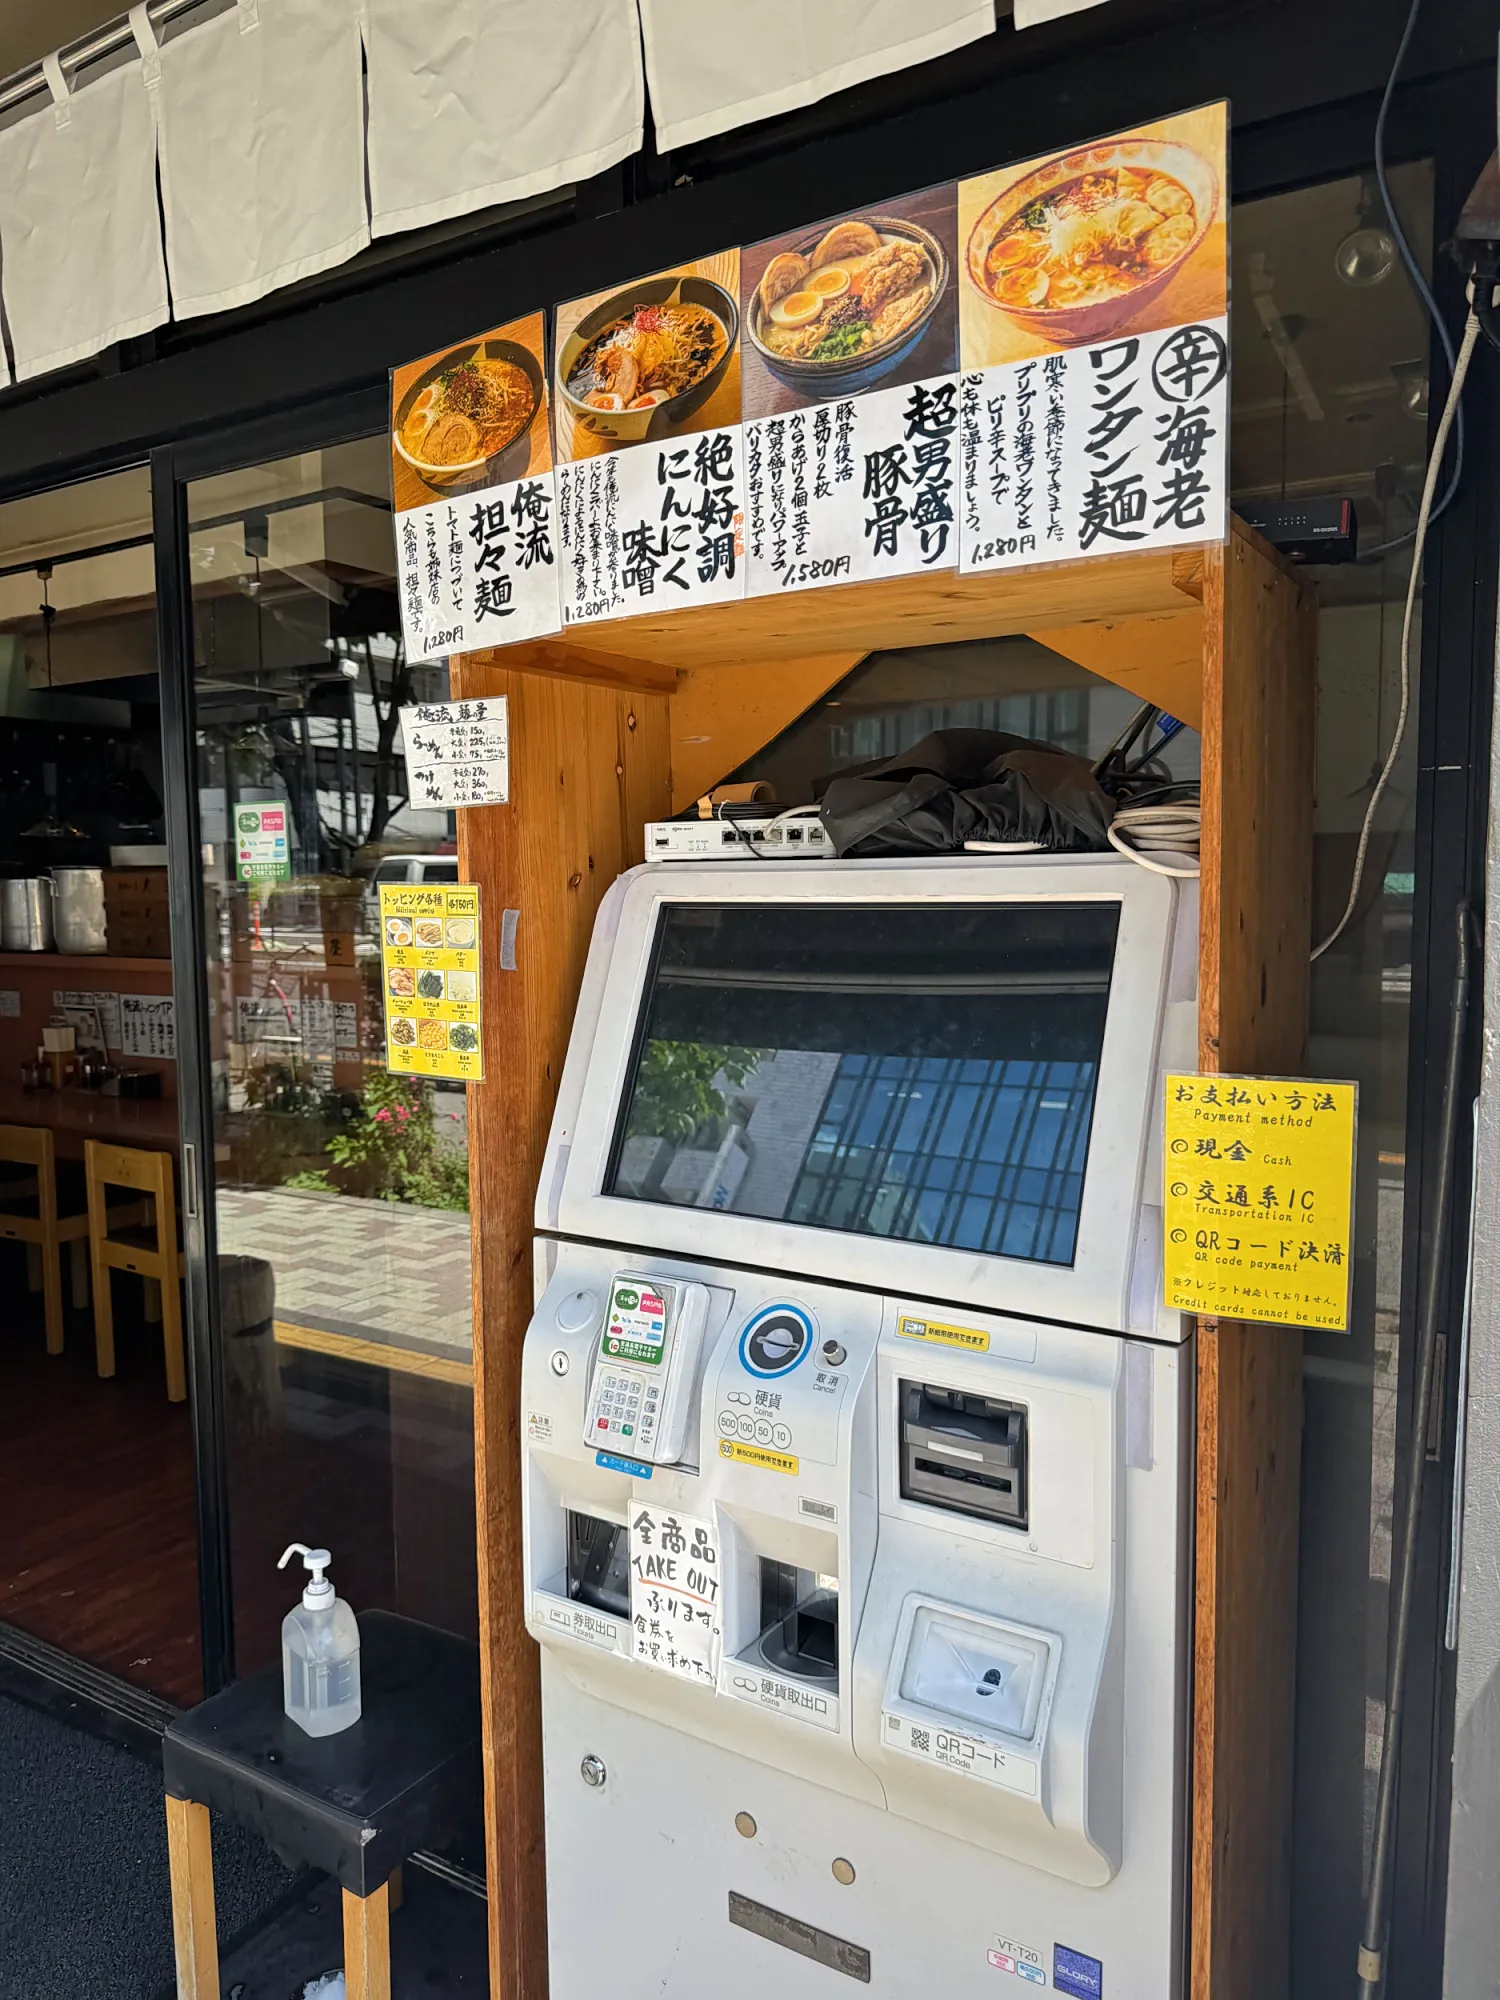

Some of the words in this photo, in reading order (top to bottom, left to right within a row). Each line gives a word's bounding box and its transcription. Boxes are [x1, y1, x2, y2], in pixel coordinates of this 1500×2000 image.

[813, 407, 834, 499] 厚切り2枚
[833, 400, 858, 484] 豚骨復活
[986, 394, 1010, 505] ピリ辛スープで
[1013, 361, 1037, 530] プリプリの海老ワンタンと
[1043, 355, 1067, 542] 肌寒い季節になってきました。
[1078, 338, 1151, 550] ワンタン麺
[746, 422, 766, 559] バリカタおすすめです。
[902, 382, 959, 565] 超男盛り
[692, 432, 739, 585] 絶好調
[764, 419, 787, 572] 超男盛りになりパワーアップ
[863, 443, 911, 558] 豚骨
[511, 481, 553, 569] 俺流
[657, 448, 693, 591] にんにく
[403, 517, 423, 633] 人気商品、担々麺です。
[425, 512, 442, 605] こちらも姉妹店の
[447, 506, 464, 610] トマト麺につづいて
[469, 500, 517, 623] 担々麺
[622, 519, 661, 597] 味噌
[383, 893, 443, 906] トッピング各種
[1175, 1084, 1337, 1111] お支払い方法
[1194, 1109, 1251, 1123] Payment
[1261, 1114, 1313, 1127] method
[1194, 1138, 1253, 1162] 現金
[1263, 1154, 1292, 1166] Cash
[1194, 1180, 1315, 1210] 交通系IC
[1195, 1204, 1293, 1222] Transportation
[1301, 1213, 1314, 1223] IC
[1194, 1252, 1208, 1262] QR
[1215, 1255, 1243, 1266] code
[1250, 1260, 1298, 1272] payment
[1195, 1229, 1346, 1266] QRコード決済
[1173, 1295, 1207, 1309] Credit
[1214, 1302, 1244, 1314] cards
[1251, 1307, 1288, 1319] cannot
[1295, 1311, 1308, 1321] be
[1315, 1314, 1345, 1326] used.
[813, 1383, 836, 1394] Cancel
[816, 1372, 839, 1386] 取消
[754, 1407, 773, 1418] Coins
[755, 1389, 782, 1410] 硬貨
[721, 1417, 736, 1429] 500
[739, 1421, 753, 1432] 100
[758, 1426, 769, 1437] 50
[777, 1430, 786, 1441] 10
[736, 1448, 794, 1468] 新500円使用できます
[632, 1510, 716, 1563] 全商品
[632, 1554, 677, 1580] TAKE
[687, 1567, 719, 1602] OUT
[572, 1611, 618, 1640] 券取出口
[572, 1626, 595, 1640] Tickets
[633, 1613, 674, 1643] 食券を
[760, 1678, 828, 1716] 硬貨取出口
[760, 1694, 781, 1708] Coins
[935, 1750, 948, 1761] QR
[949, 1755, 971, 1770] Code
[936, 1733, 1006, 1769] QRコード
[998, 1938, 1038, 1963] VT-T20
[1057, 1964, 1097, 1987] GLORY
